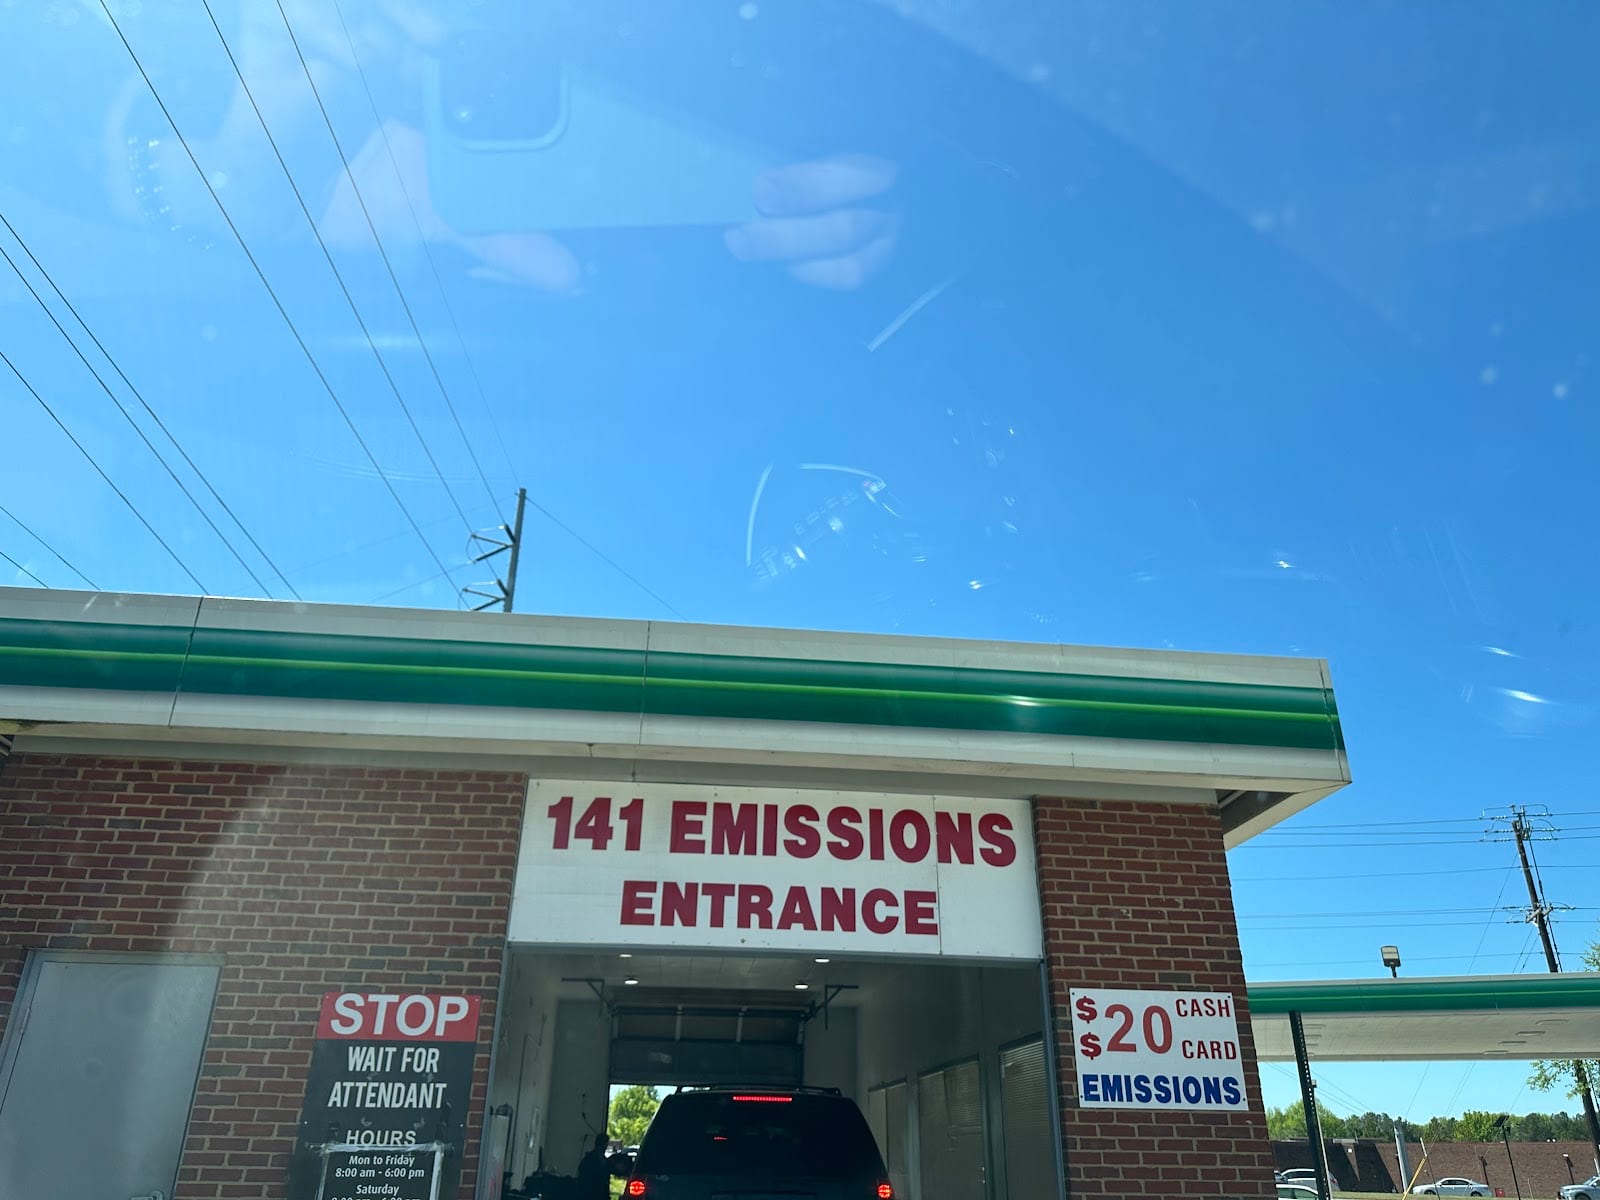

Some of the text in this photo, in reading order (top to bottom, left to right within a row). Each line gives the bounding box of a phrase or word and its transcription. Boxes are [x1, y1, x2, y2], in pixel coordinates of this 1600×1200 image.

[547, 796, 1017, 867] 141 EMISSIONS
[620, 880, 939, 936] ENTRANCE
[330, 993, 469, 1037] STOP
[1175, 998, 1231, 1018] CASH
[348, 1046, 440, 1073] WAIT FOR
[1181, 1040, 1237, 1060] CARD
[327, 1081, 447, 1109] ATTENDANT
[1082, 1073, 1241, 1105] EMISSIONS
[345, 1130, 417, 1147] HOURS
[348, 1154, 415, 1167] Mon to Friday
[335, 1167, 357, 1178] 8:00
[359, 1169, 376, 1178] am
[384, 1167, 407, 1178] 6:00
[408, 1169, 425, 1179] pm
[356, 1183, 400, 1196] Saturday
